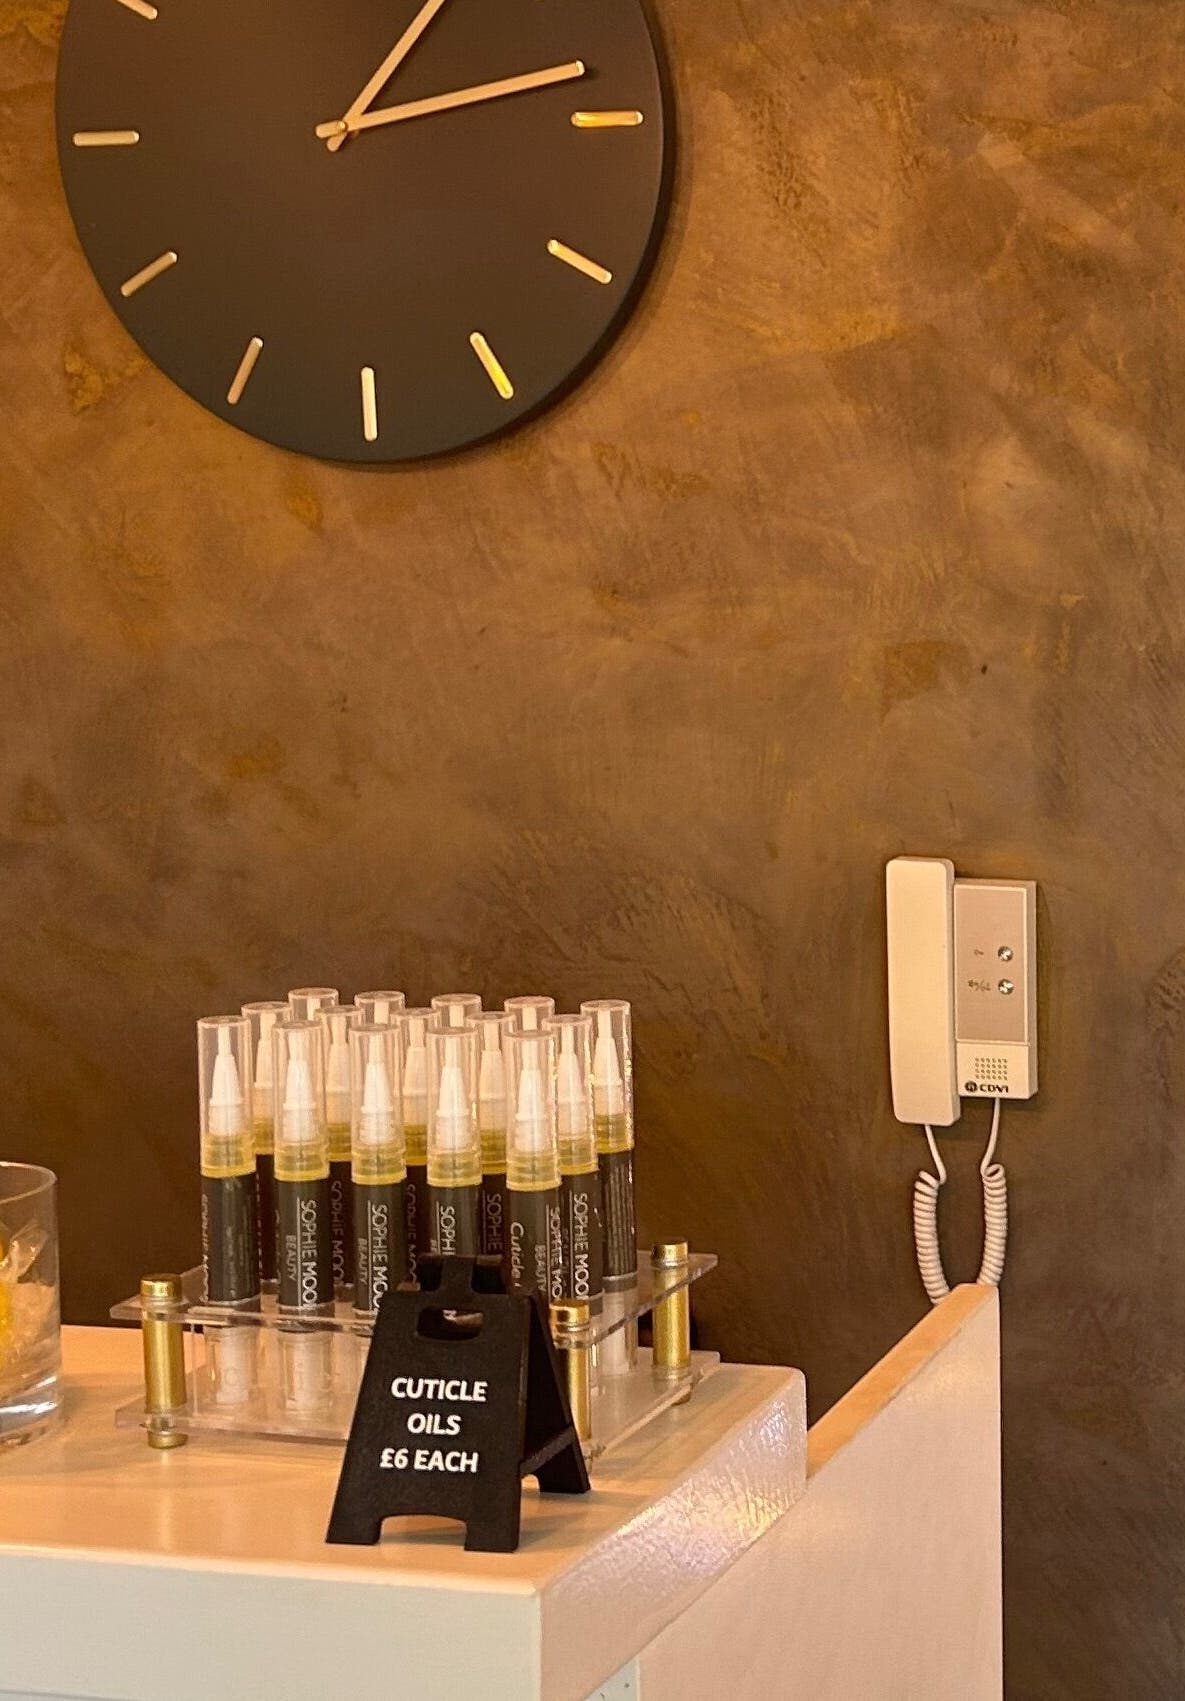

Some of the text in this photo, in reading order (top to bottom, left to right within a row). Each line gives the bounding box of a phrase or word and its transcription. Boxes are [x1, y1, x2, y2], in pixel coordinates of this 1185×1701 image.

[372, 1203, 389, 1262] SOPHIE
[439, 1205, 456, 1255] SOPHI
[486, 1193, 503, 1254] SOPHIE
[573, 1192, 590, 1300] SOPHIE MOO
[285, 1234, 298, 1281] BEAUTY
[300, 1199, 319, 1310] SOPHIE MOO
[534, 1244, 547, 1292] BEAUTY
[391, 1377, 488, 1402] CUTICLE
[407, 1412, 462, 1435] OILS
[379, 1447, 479, 1473] £6 EACH
